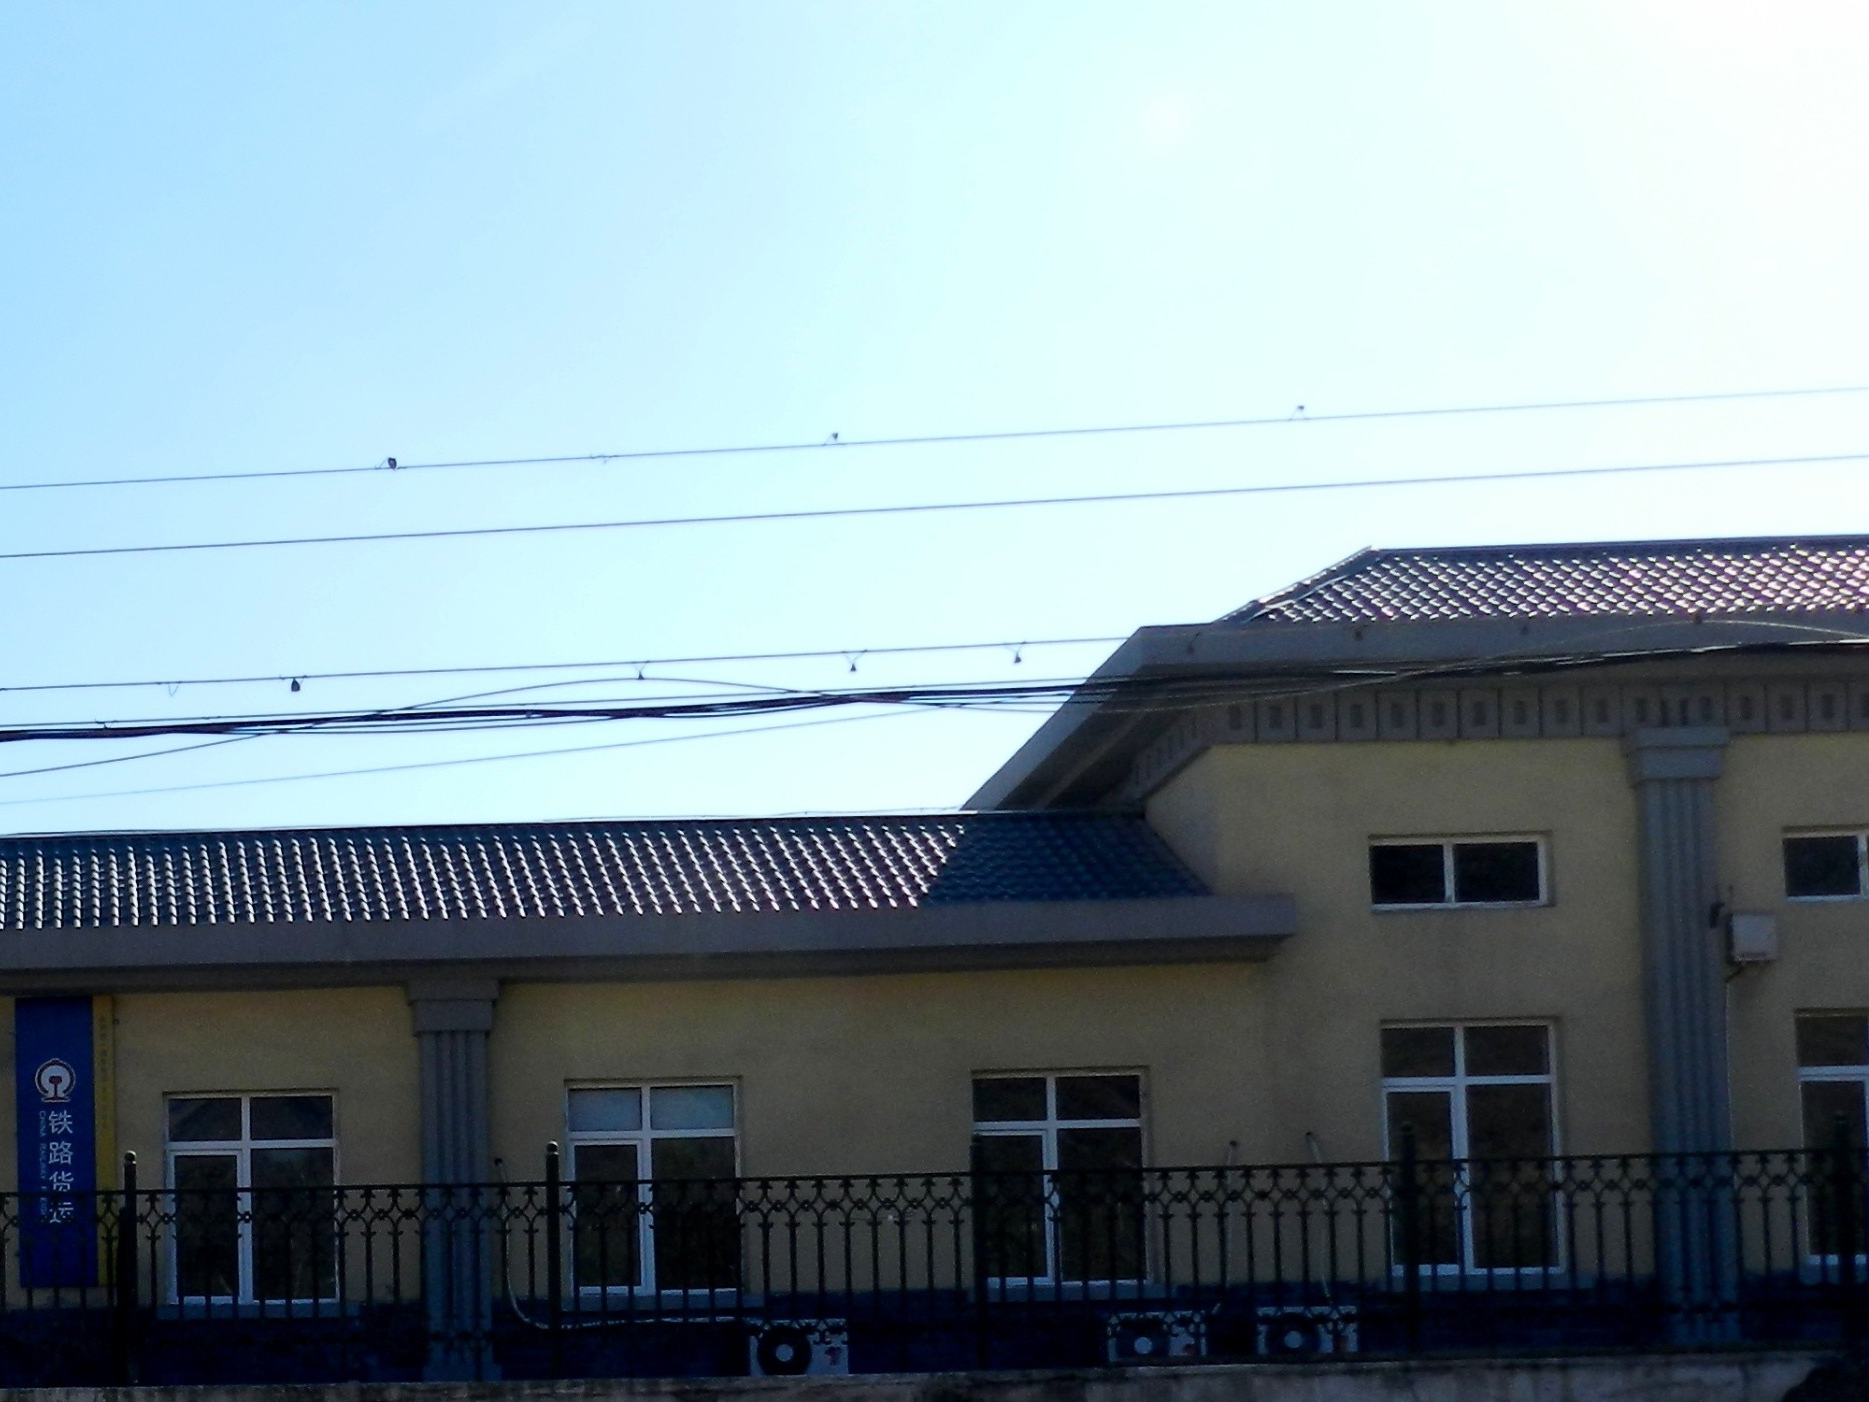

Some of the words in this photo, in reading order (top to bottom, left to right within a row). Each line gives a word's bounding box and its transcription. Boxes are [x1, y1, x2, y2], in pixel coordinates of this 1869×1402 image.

[38, 1110, 47, 1137] CHINA
[48, 1110, 75, 1224] 铁路货运
